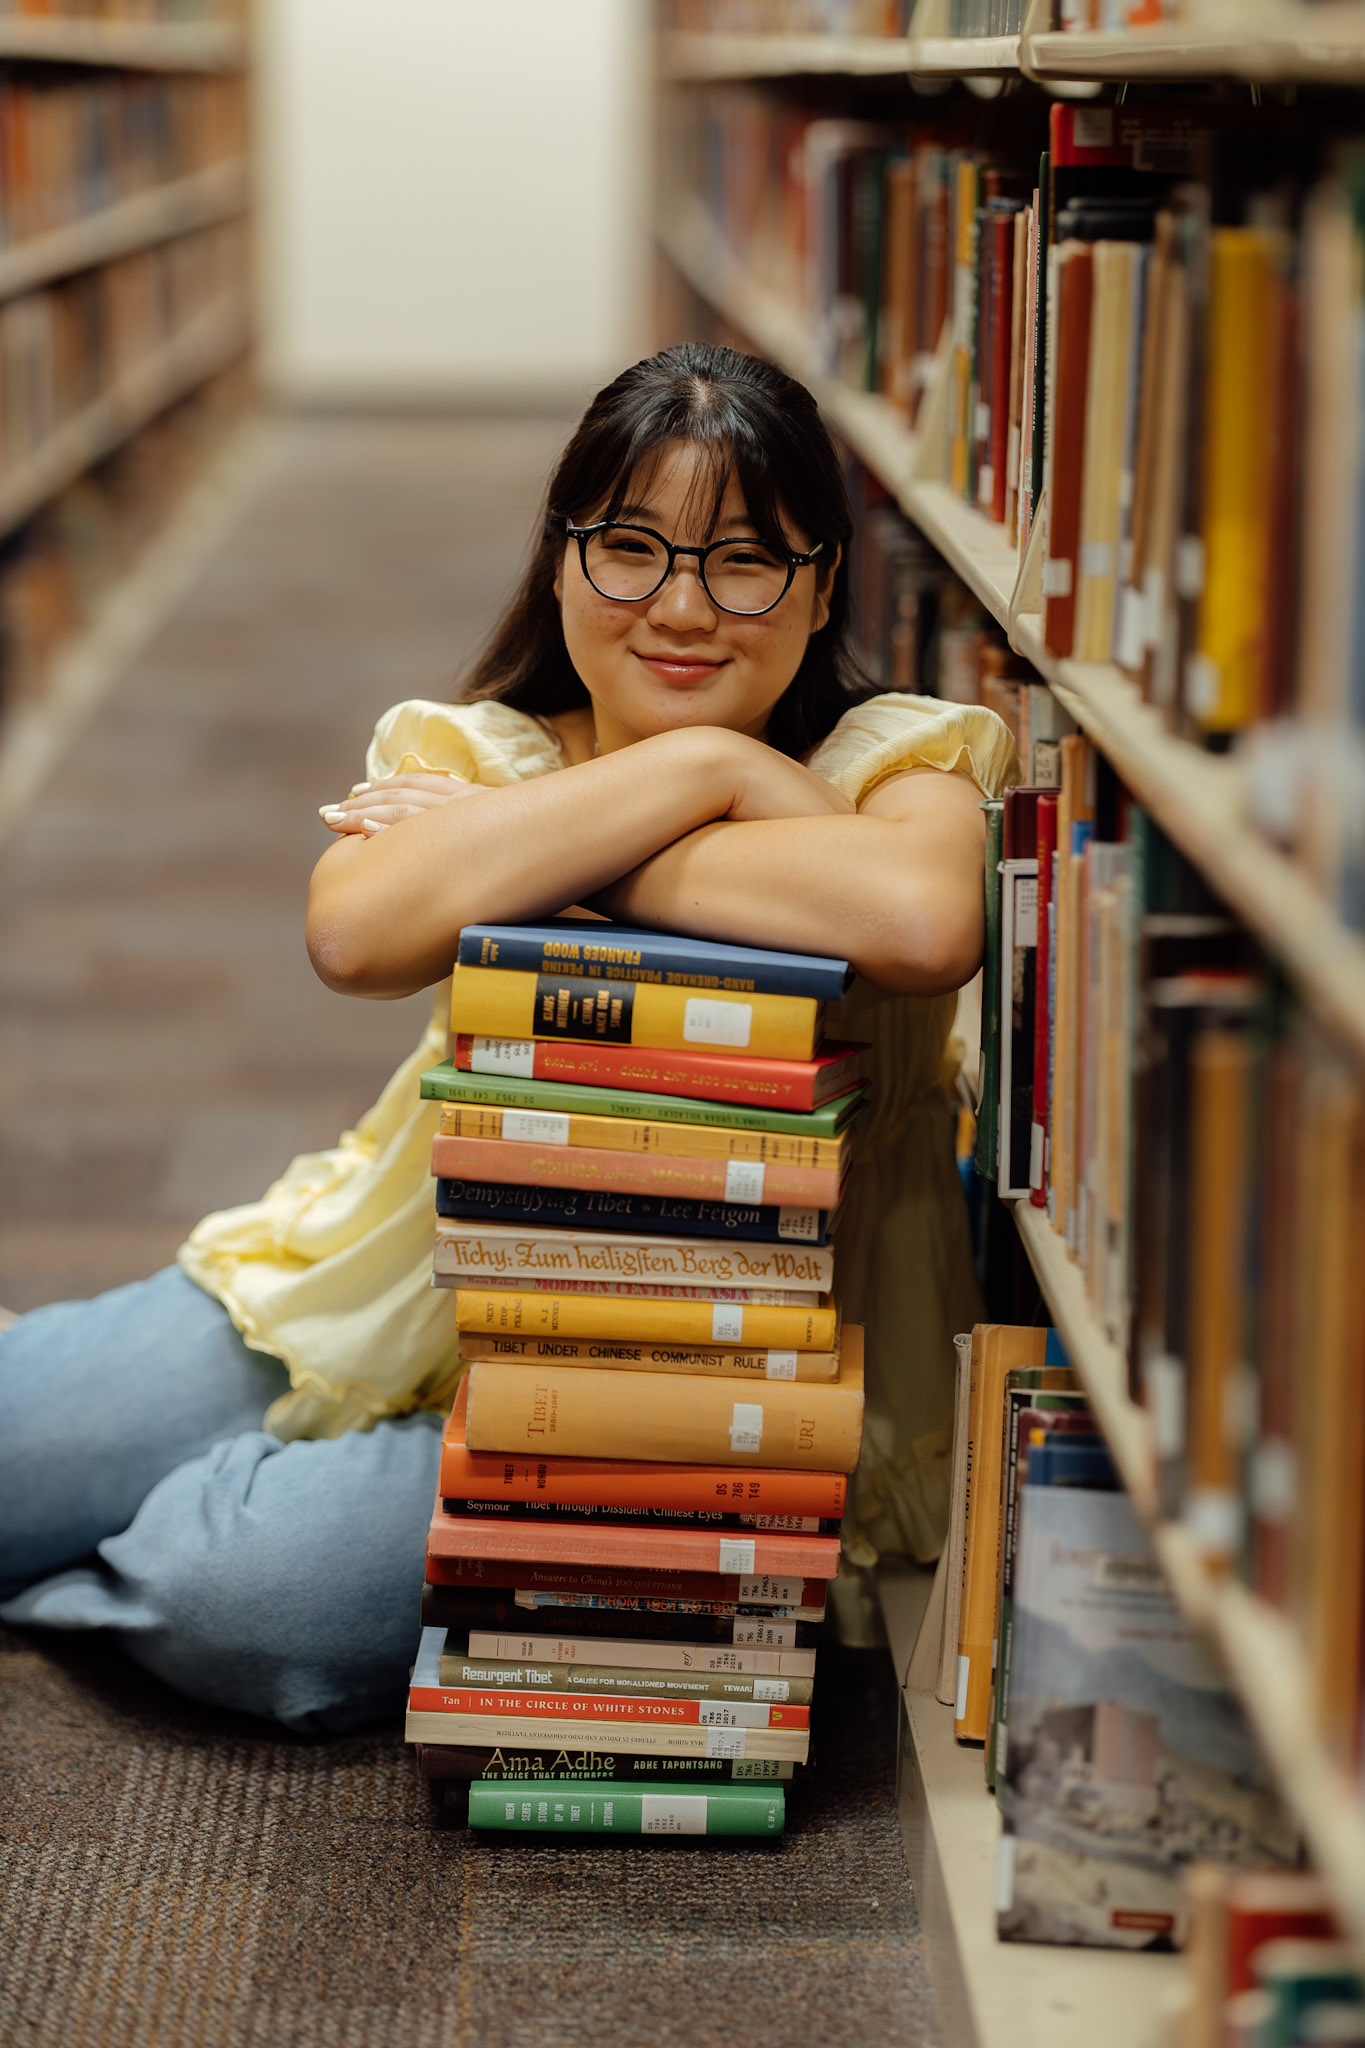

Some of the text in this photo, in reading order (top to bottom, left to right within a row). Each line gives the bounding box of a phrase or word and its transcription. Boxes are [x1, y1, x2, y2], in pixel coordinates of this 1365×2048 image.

[542, 942, 641, 966] FRANCES WOOD
[541, 960, 755, 991] HAND-GRENADE PRACTICE IN PEKING
[543, 995, 556, 1022] KLAUS
[582, 998, 595, 1025] CHINA
[543, 1056, 576, 1069] WONG
[621, 1065, 658, 1079] FOUND
[662, 1071, 688, 1082] AND
[530, 1158, 600, 1178] CHINA
[448, 1180, 761, 1228] Demystifying Tibet Lee Feigon
[444, 1240, 514, 1273] Tichy:
[515, 1242, 573, 1269] Zum
[677, 1247, 735, 1281] Berg
[734, 1251, 773, 1277] der
[771, 1253, 823, 1281] Welt
[533, 1279, 750, 1302] MODERN CENTRAL ASIA
[486, 1302, 495, 1324] NEXT
[514, 1298, 523, 1329] PEKING
[492, 1340, 766, 1370] TIBET UNDER CHINESE COMMUNIST RULE
[527, 1384, 549, 1439] TIBET
[798, 1419, 816, 1451] URI
[504, 1463, 514, 1485] TIBET
[537, 1464, 547, 1489] NORBU
[716, 1483, 727, 1496] DS
[732, 1482, 744, 1498] 786
[748, 1482, 761, 1499] T49
[467, 1499, 511, 1512] Seymour
[556, 1502, 598, 1516] Through
[602, 1504, 649, 1517] Dissident
[653, 1507, 695, 1519] Chinese
[698, 1509, 724, 1522] Eyes
[759, 1517, 767, 1527] DS
[768, 1514, 776, 1528] 786
[530, 1572, 567, 1584] Answers
[569, 1575, 578, 1585] to
[580, 1574, 613, 1586] China's
[615, 1579, 632, 1588] 100
[741, 1586, 749, 1597] DS
[751, 1585, 759, 1598] 786
[771, 1583, 779, 1599] 2007
[599, 1597, 639, 1609] FROM
[645, 1598, 677, 1611] 1951
[682, 1599, 702, 1611] TO
[706, 1601, 738, 1615] 1991
[737, 1633, 744, 1642] DS
[746, 1631, 754, 1642] 786
[766, 1629, 774, 1644] 2008
[709, 1659, 716, 1669] DS
[462, 1666, 553, 1685] Resurgent Tibet
[599, 1678, 615, 1686] FOR
[616, 1679, 665, 1689] NONALIGNED
[666, 1682, 710, 1692] MOVEMENT
[442, 1696, 461, 1705] Tan
[480, 1698, 686, 1716] IN THE CIRCLE OF WHITE STONES
[701, 1714, 708, 1725] DS
[731, 1715, 737, 1726] mn
[496, 1730, 527, 1738] TANTRISM
[529, 1732, 584, 1741] INDO-INDONESIAN
[484, 1747, 617, 1772] Ama Adhe
[633, 1760, 723, 1770] ADHE TAPONTSANG
[482, 1772, 614, 1780] THE VOICE THAT REMEMBERS
[736, 1766, 745, 1777] DS
[745, 1763, 753, 1777] 786
[753, 1763, 762, 1777] T37
[762, 1761, 771, 1777] 1997
[505, 1803, 516, 1821] WHEN
[522, 1802, 532, 1822] SERFS
[538, 1801, 548, 1823] STOOD
[554, 1803, 565, 1823] UP IN
[570, 1804, 581, 1822] TIBET
[603, 1801, 615, 1827] STRONG
[647, 1822, 653, 1830] DS
